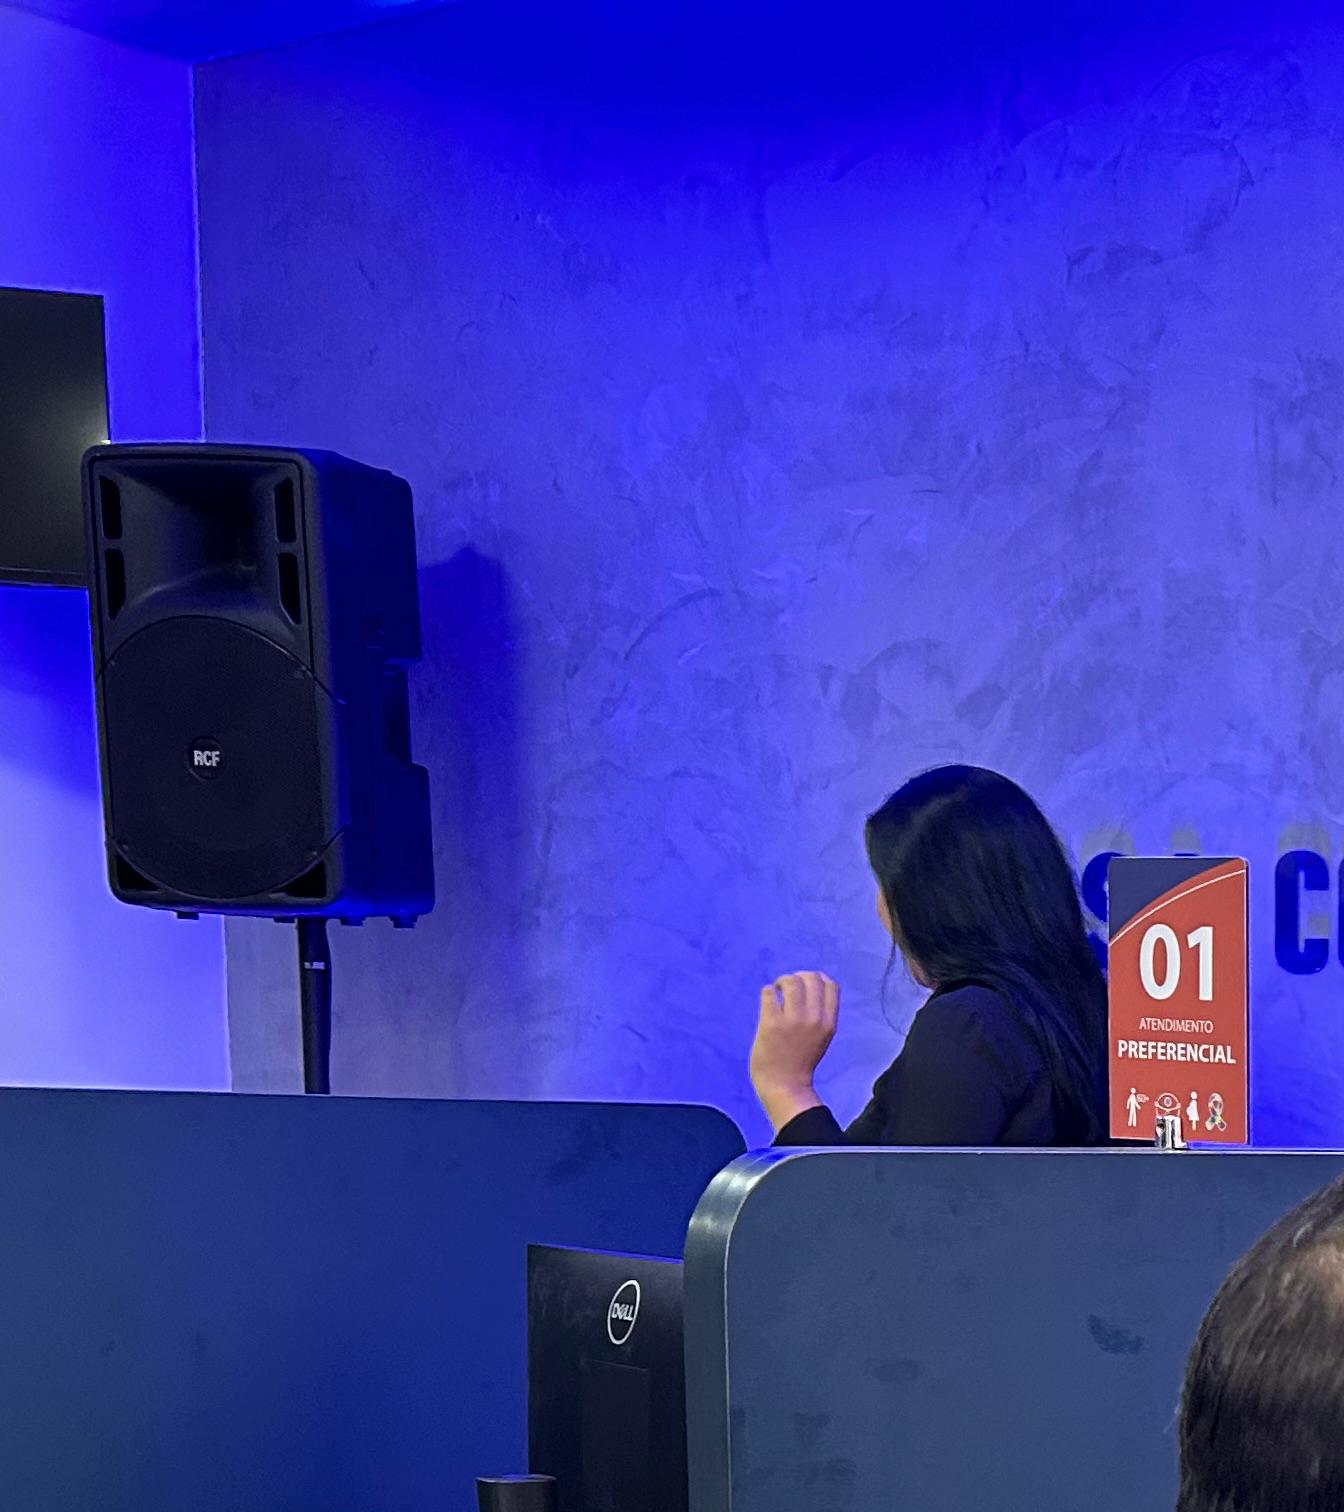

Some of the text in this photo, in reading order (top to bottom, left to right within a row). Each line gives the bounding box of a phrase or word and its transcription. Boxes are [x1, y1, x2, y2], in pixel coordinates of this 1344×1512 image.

[193, 749, 220, 767] RCF
[1139, 923, 1214, 1001] 01
[1138, 1016, 1214, 1034] ATENDIMENTO
[1117, 1039, 1237, 1064] PREFERENCIAL
[611, 1302, 635, 1321] DELL
